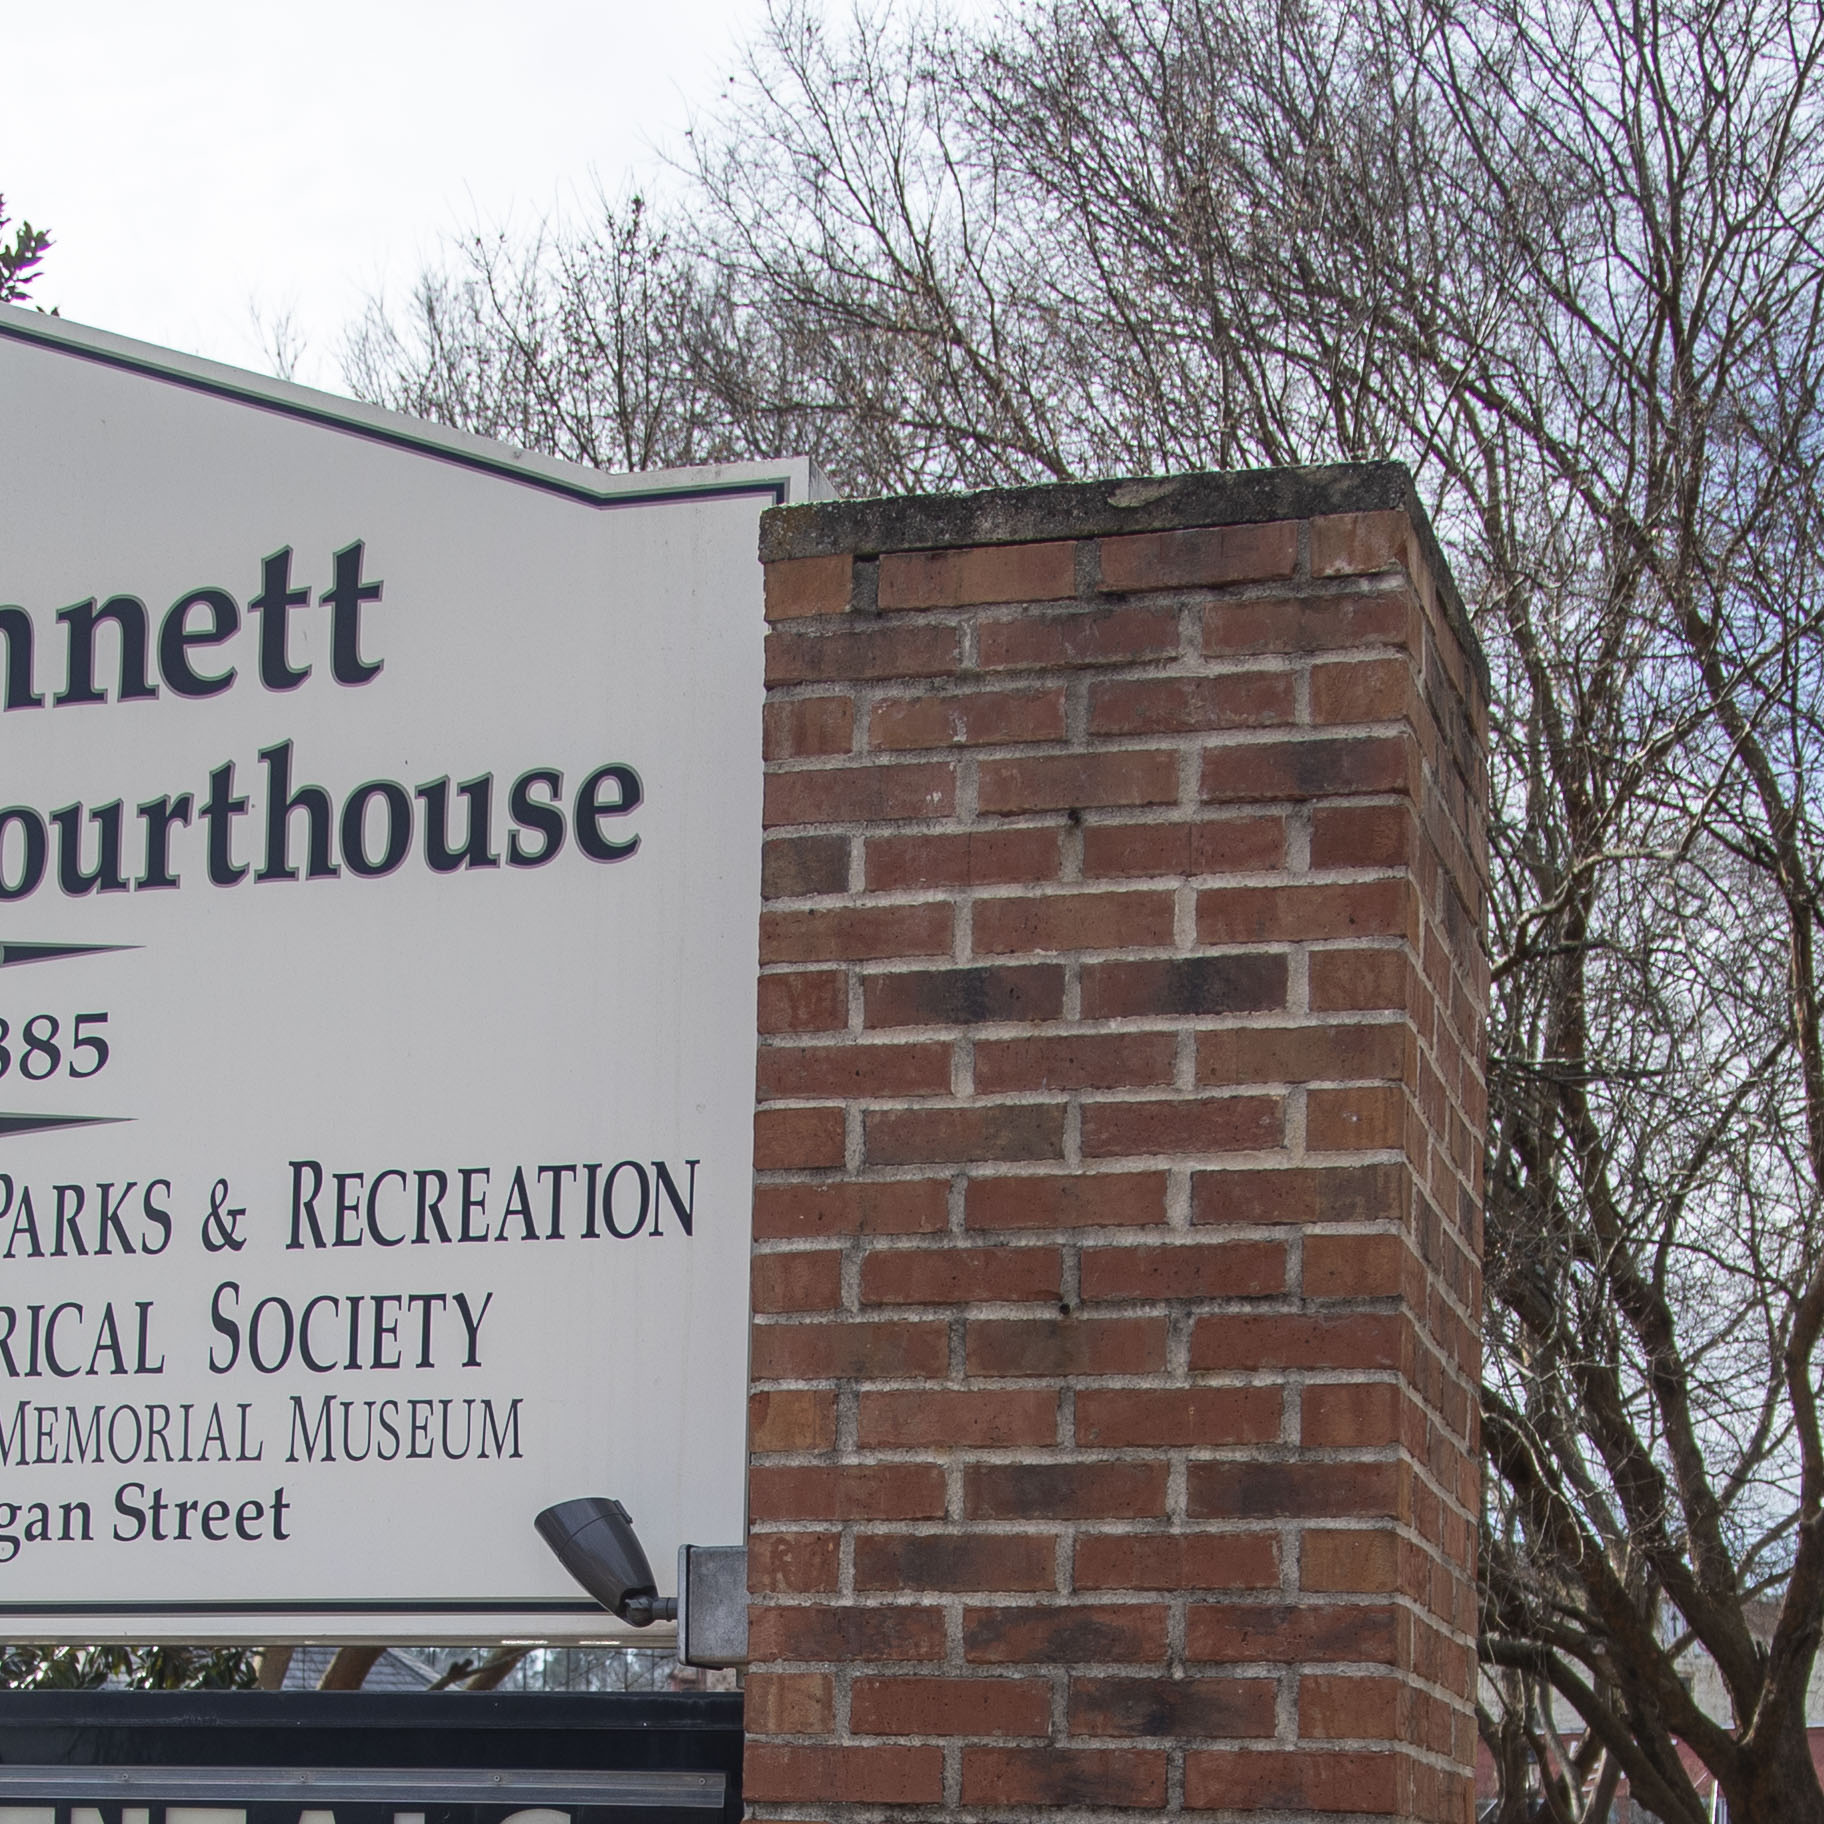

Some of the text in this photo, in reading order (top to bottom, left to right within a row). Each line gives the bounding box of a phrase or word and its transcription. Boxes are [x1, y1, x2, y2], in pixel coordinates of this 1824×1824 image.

[202, 1179, 246, 1252] &
[286, 1160, 700, 1249] RECREATION
[209, 1281, 493, 1374] SOCIETY
[286, 1395, 523, 1462] MUSEUM
[114, 1483, 290, 1541] Street
